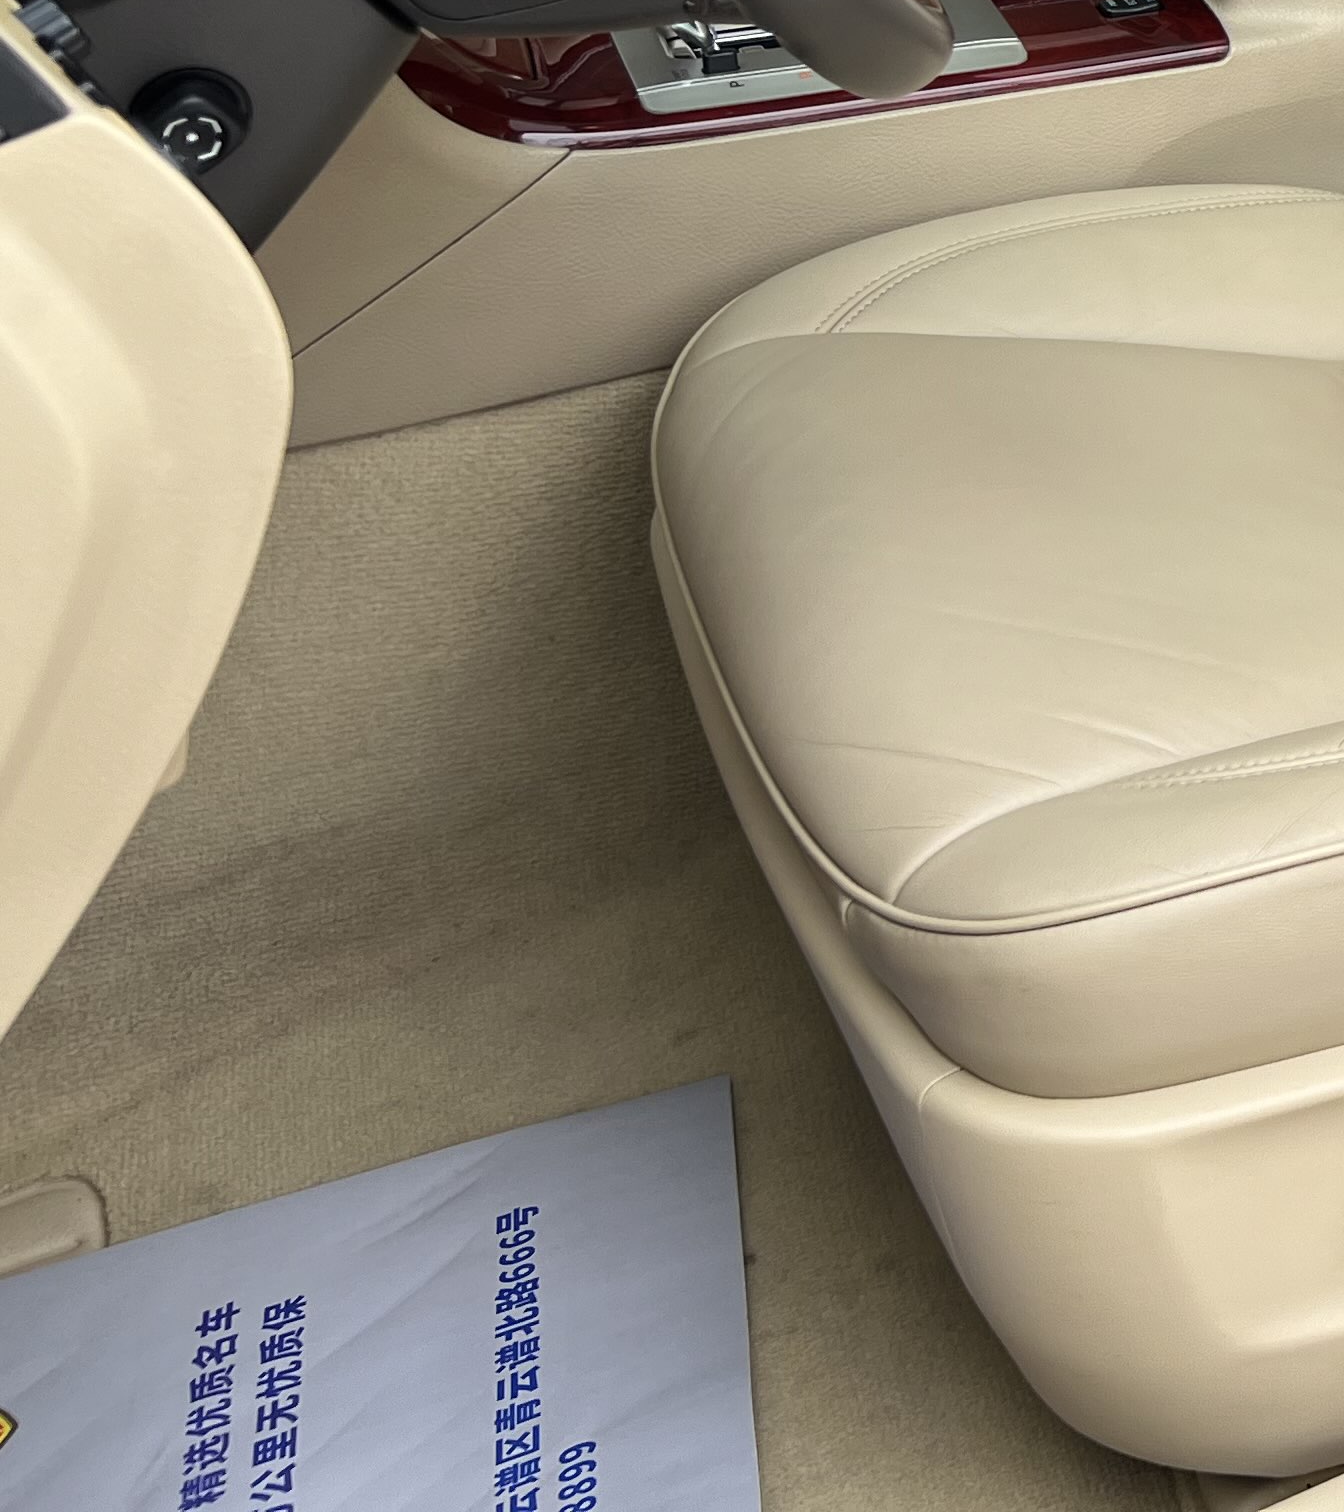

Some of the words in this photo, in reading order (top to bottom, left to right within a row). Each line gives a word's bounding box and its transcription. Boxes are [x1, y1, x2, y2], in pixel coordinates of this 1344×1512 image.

[178, 1300, 241, 1512] 精选优质名车
[250, 1295, 307, 1512] 公里无忧质保
